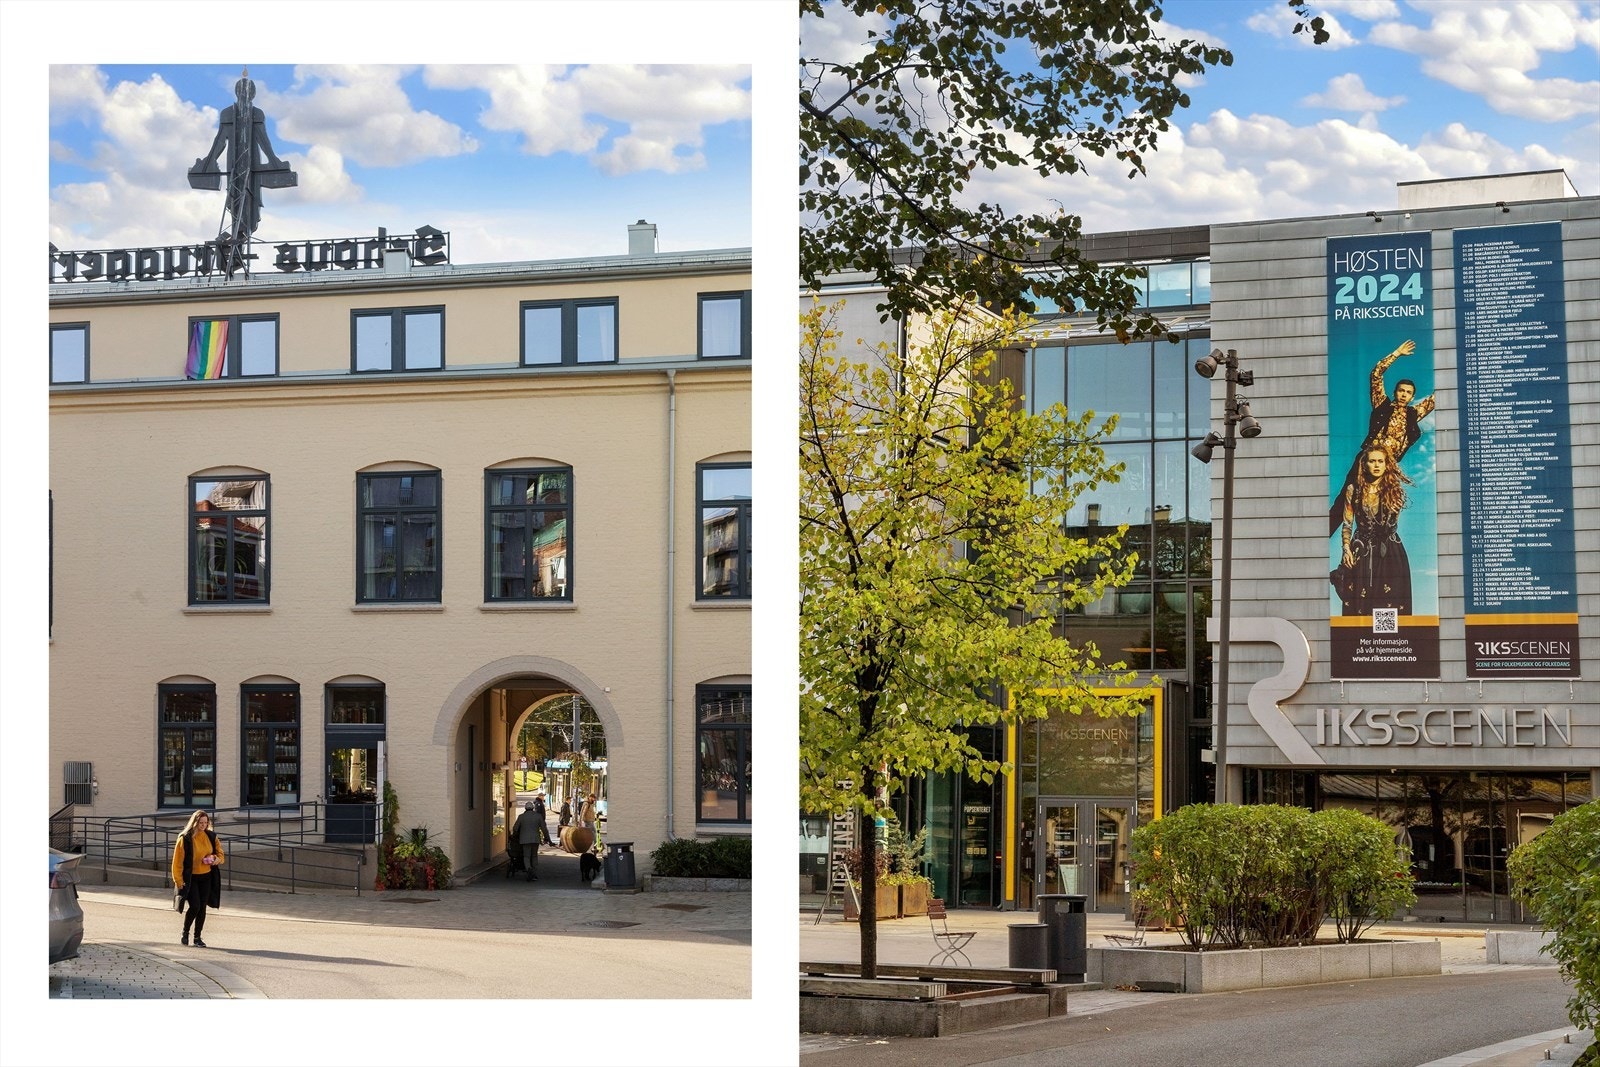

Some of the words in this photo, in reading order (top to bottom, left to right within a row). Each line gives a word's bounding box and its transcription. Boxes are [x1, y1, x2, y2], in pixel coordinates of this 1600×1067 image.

[1334, 247, 1424, 273] HØSTEN
[1335, 272, 1424, 304] 2024
[1335, 306, 1351, 320] PÅ
[1353, 305, 1424, 320] RIKSSCENEN
[1372, 638, 1408, 647] informasjon
[1474, 642, 1570, 655] RIKSSCENEN
[1356, 646, 1364, 654] på
[1366, 646, 1375, 654] vår
[1376, 646, 1412, 654] hjemmeside
